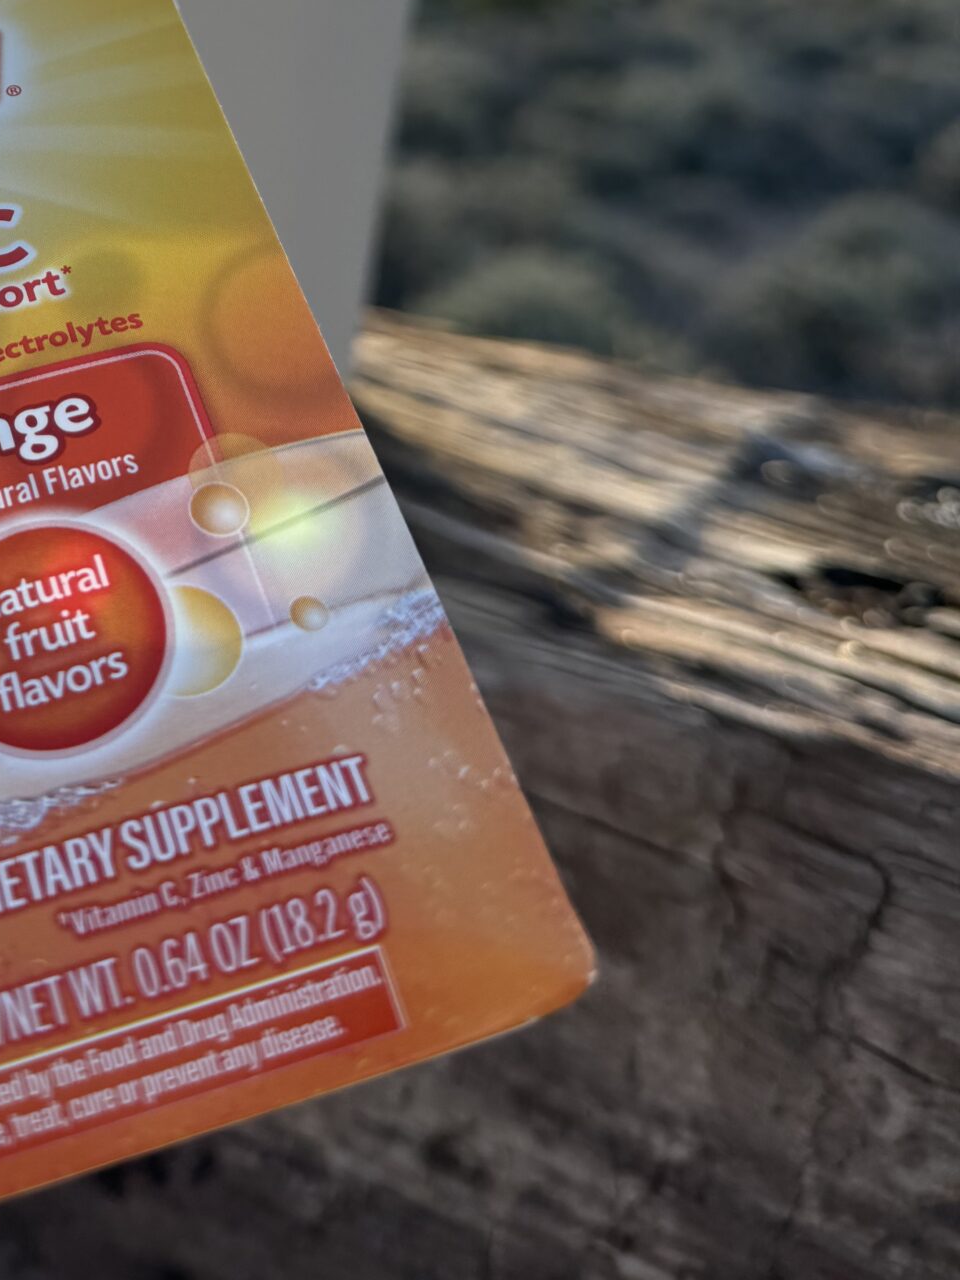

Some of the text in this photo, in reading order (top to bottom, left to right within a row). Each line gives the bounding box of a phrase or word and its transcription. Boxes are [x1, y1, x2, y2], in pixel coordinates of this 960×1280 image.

[42, 452, 139, 496] Flavors
[3, 608, 97, 661] fruit
[120, 755, 372, 870] SUPPLEMENT
[159, 880, 188, 906] C,
[187, 867, 239, 899] Zinc
[240, 855, 262, 882] &
[261, 821, 392, 876] Manganese
[67, 956, 135, 1018] WT.
[132, 931, 209, 998] 0.64
[209, 915, 263, 974] OZ
[260, 887, 347, 962] (18.2
[347, 877, 385, 942] g)
[10, 1102, 69, 1139] treat,
[68, 1088, 116, 1121] cure
[116, 1081, 139, 1106] or
[141, 1051, 222, 1104] prevent
[220, 1040, 261, 1073] any
[260, 1014, 347, 1059] disease.
[23, 1069, 54, 1098] by
[51, 1058, 88, 1088] the
[87, 1036, 138, 1076] Food
[138, 1022, 178, 1061] and
[176, 1012, 230, 1047] Drug
[227, 964, 383, 1030] Administration.
